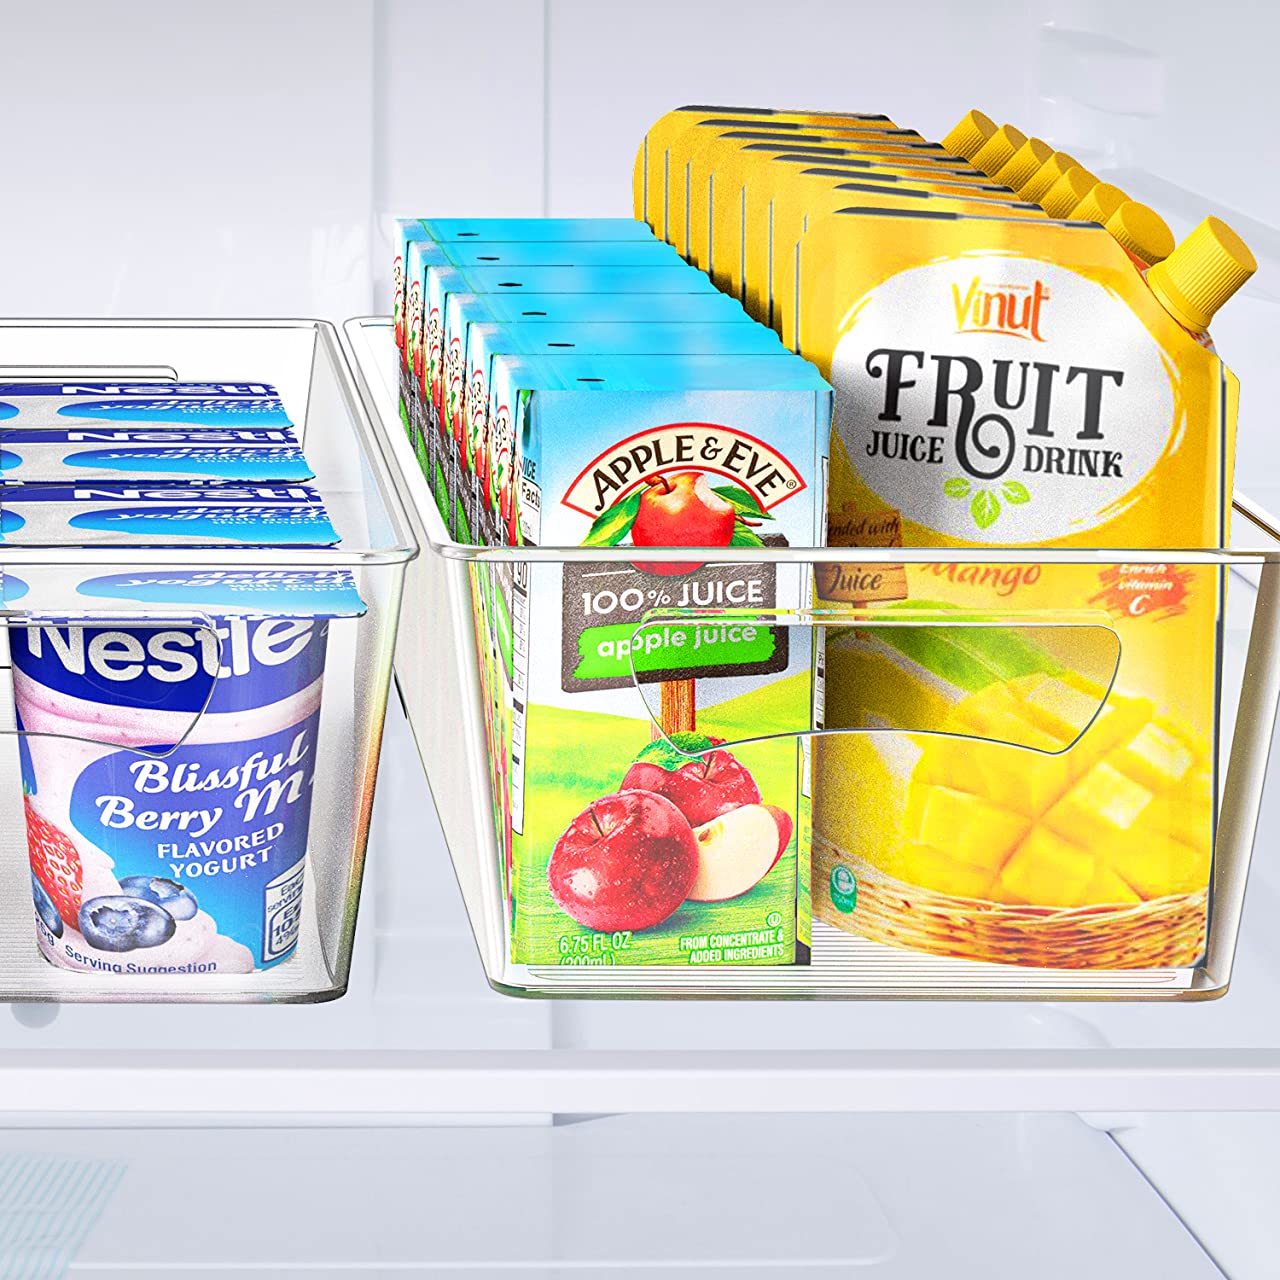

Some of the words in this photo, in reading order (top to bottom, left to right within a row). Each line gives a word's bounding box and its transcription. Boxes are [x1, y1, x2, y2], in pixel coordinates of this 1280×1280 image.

[952, 275, 1050, 342] Vinut
[865, 348, 1124, 479] FRUIT
[866, 430, 944, 463] JUICE
[1023, 445, 1123, 477] DRINK
[594, 434, 694, 511] APPLE
[700, 436, 723, 460] &
[722, 439, 786, 497] EVE
[829, 565, 884, 594] Juice
[581, 587, 670, 616] 100%
[677, 579, 763, 607] JUICE
[1129, 594, 1151, 615] C
[693, 625, 757, 650] juice
[129, 729, 309, 793] Blissful
[95, 795, 223, 838] Berry
[157, 822, 285, 859] FLAVORED
[170, 845, 273, 878] YOGURT
[560, 934, 588, 953] 6.75
[592, 933, 611, 951] FL
[612, 931, 632, 950] OZ
[680, 936, 707, 951] FROM
[709, 930, 776, 948] CONCENTRATE
[776, 928, 784, 942] &
[689, 949, 722, 964] ADDED
[723, 943, 784, 961] INGREDIENTS
[65, 944, 121, 973] Serving
